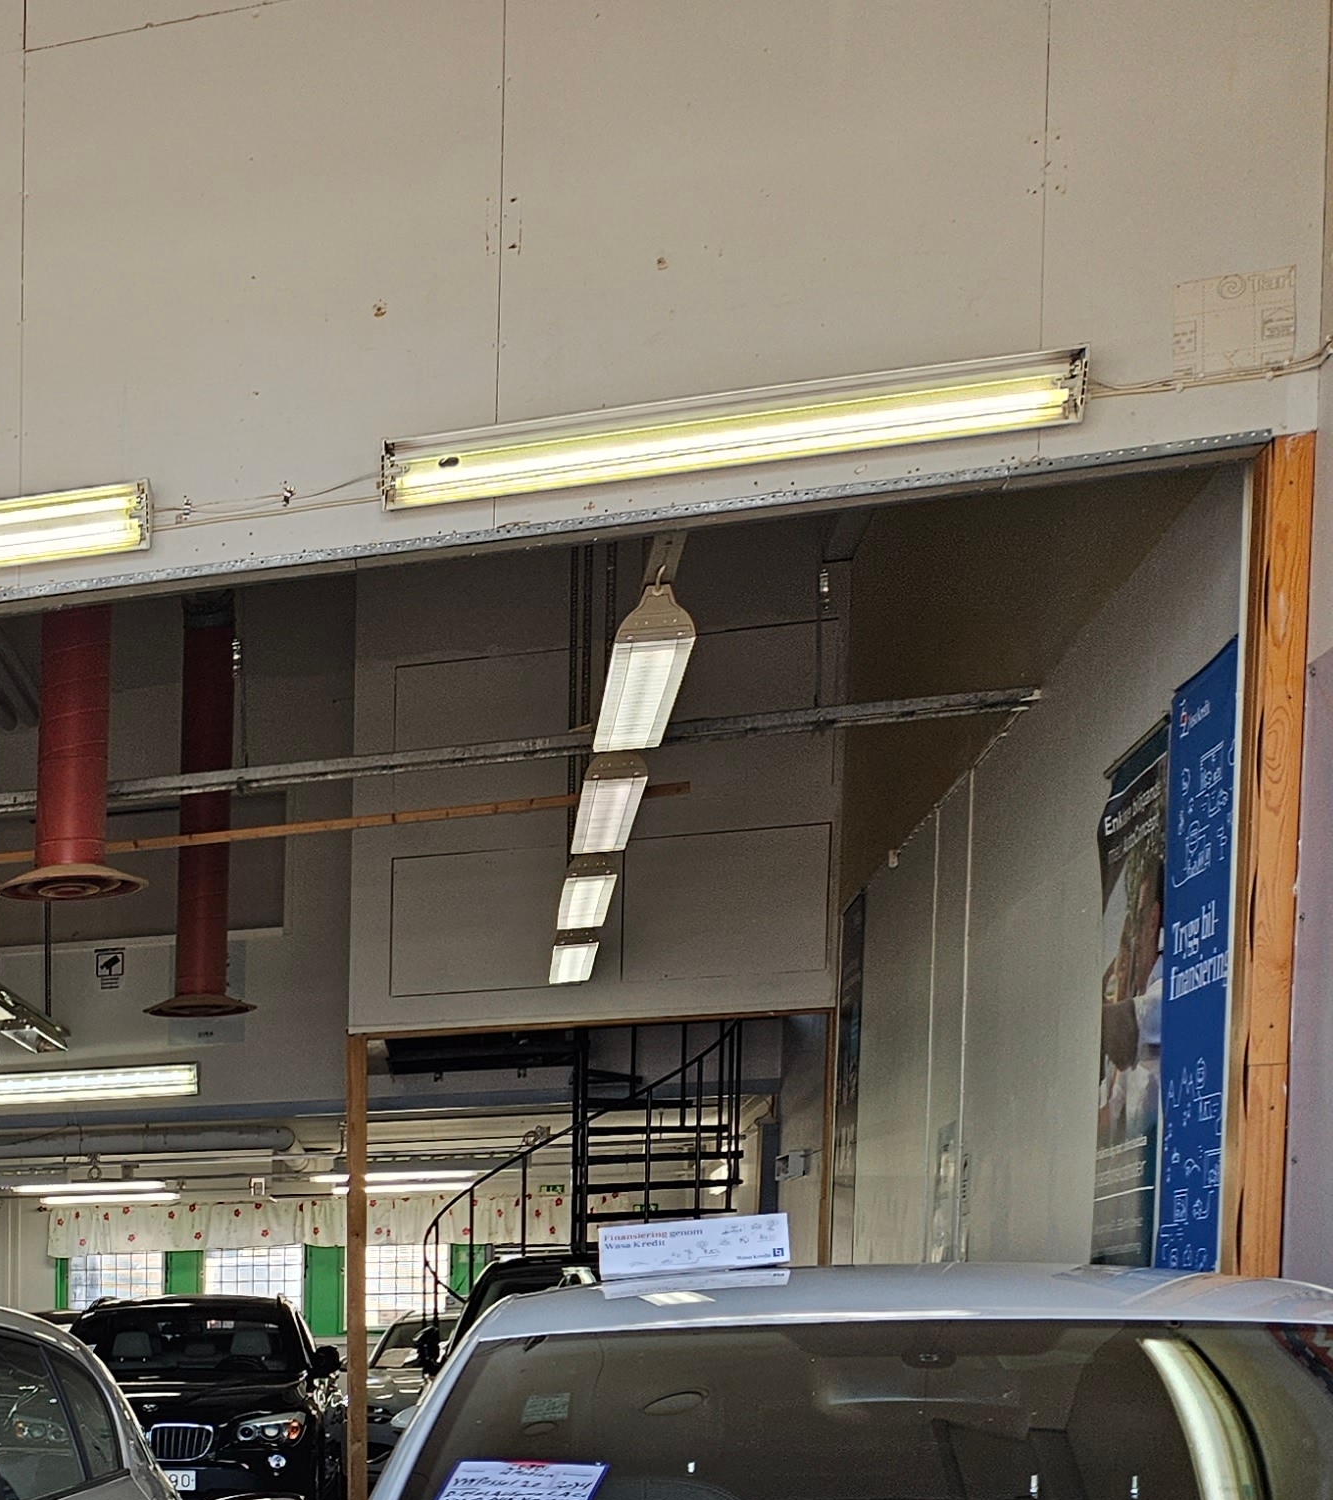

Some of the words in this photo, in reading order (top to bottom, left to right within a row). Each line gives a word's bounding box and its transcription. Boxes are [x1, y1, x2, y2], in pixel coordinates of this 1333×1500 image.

[1172, 917, 1201, 960] Trygg
[603, 1230, 668, 1242] Finansiering
[669, 1228, 703, 1239] genom
[604, 1241, 631, 1250] Wasa
[632, 1239, 666, 1248] Kredit
